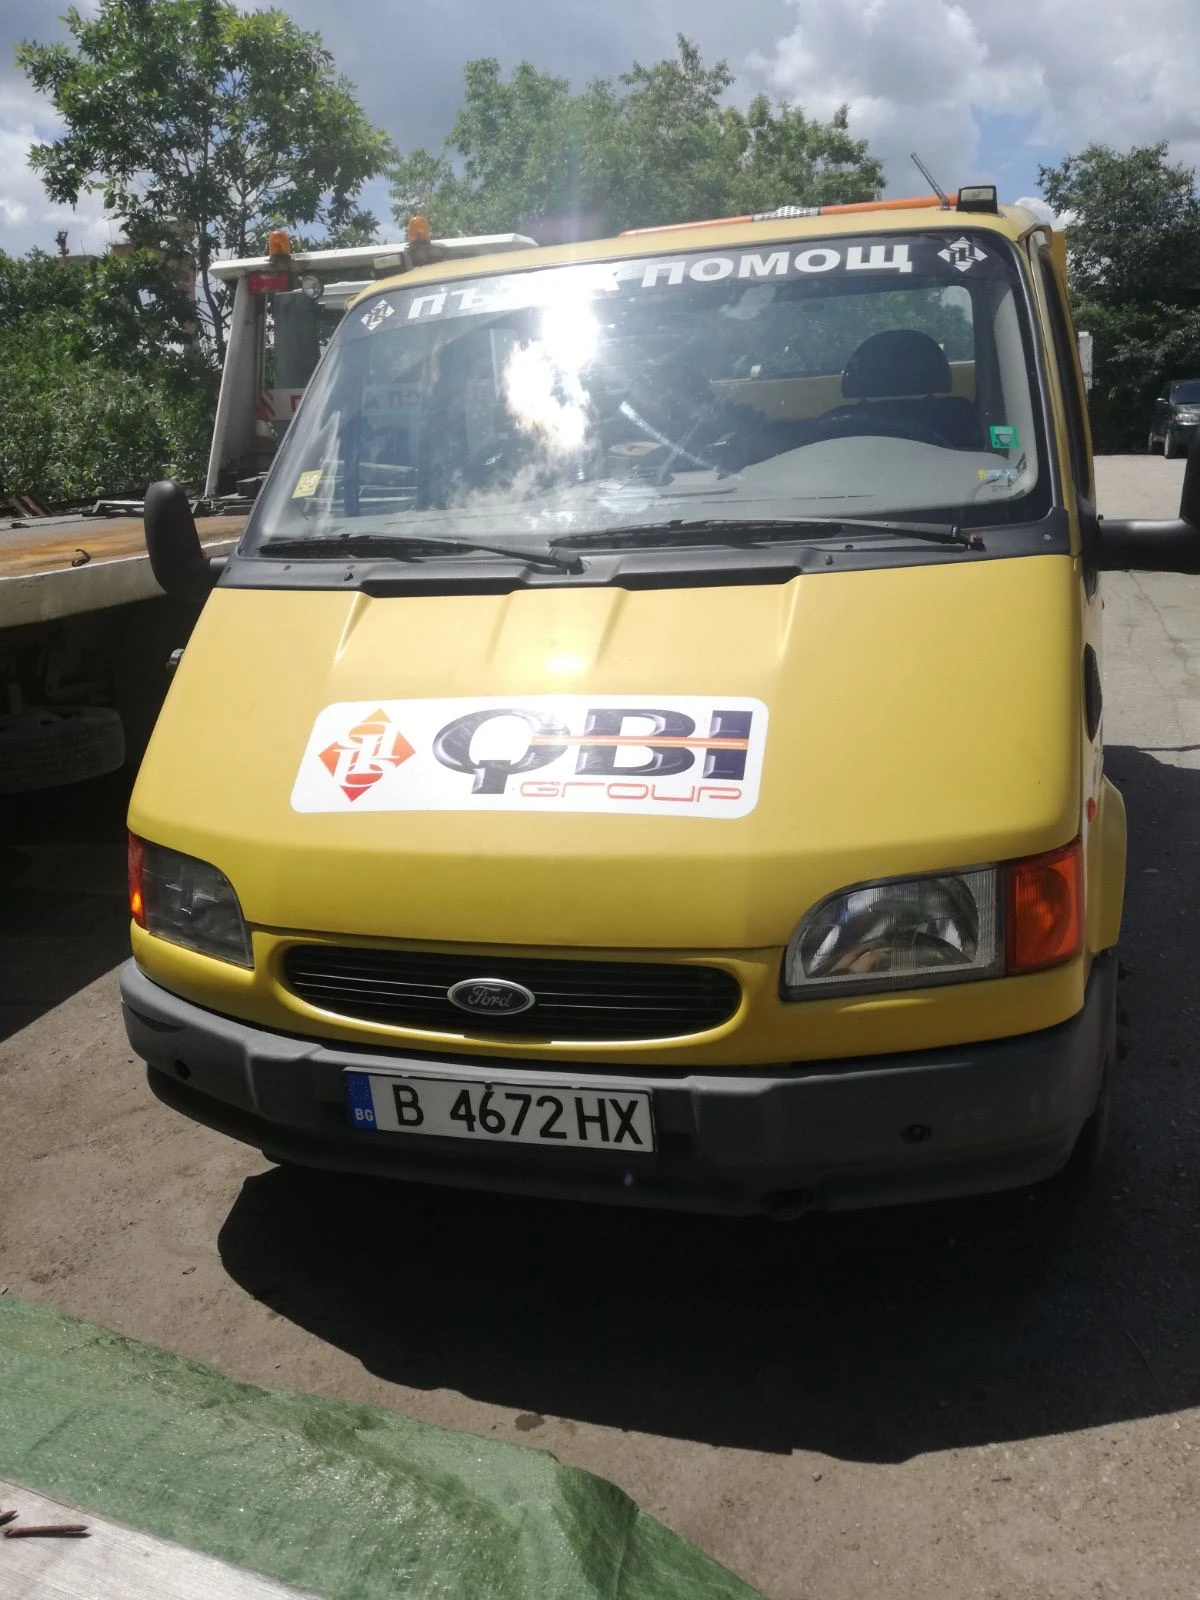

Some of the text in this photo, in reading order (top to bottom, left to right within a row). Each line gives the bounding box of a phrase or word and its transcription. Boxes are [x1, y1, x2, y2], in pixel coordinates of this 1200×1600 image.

[642, 244, 913, 288] ПОМОЩ
[432, 708, 753, 794] QBI
[467, 985, 513, 1007] Ford
[355, 1108, 374, 1122] BG
